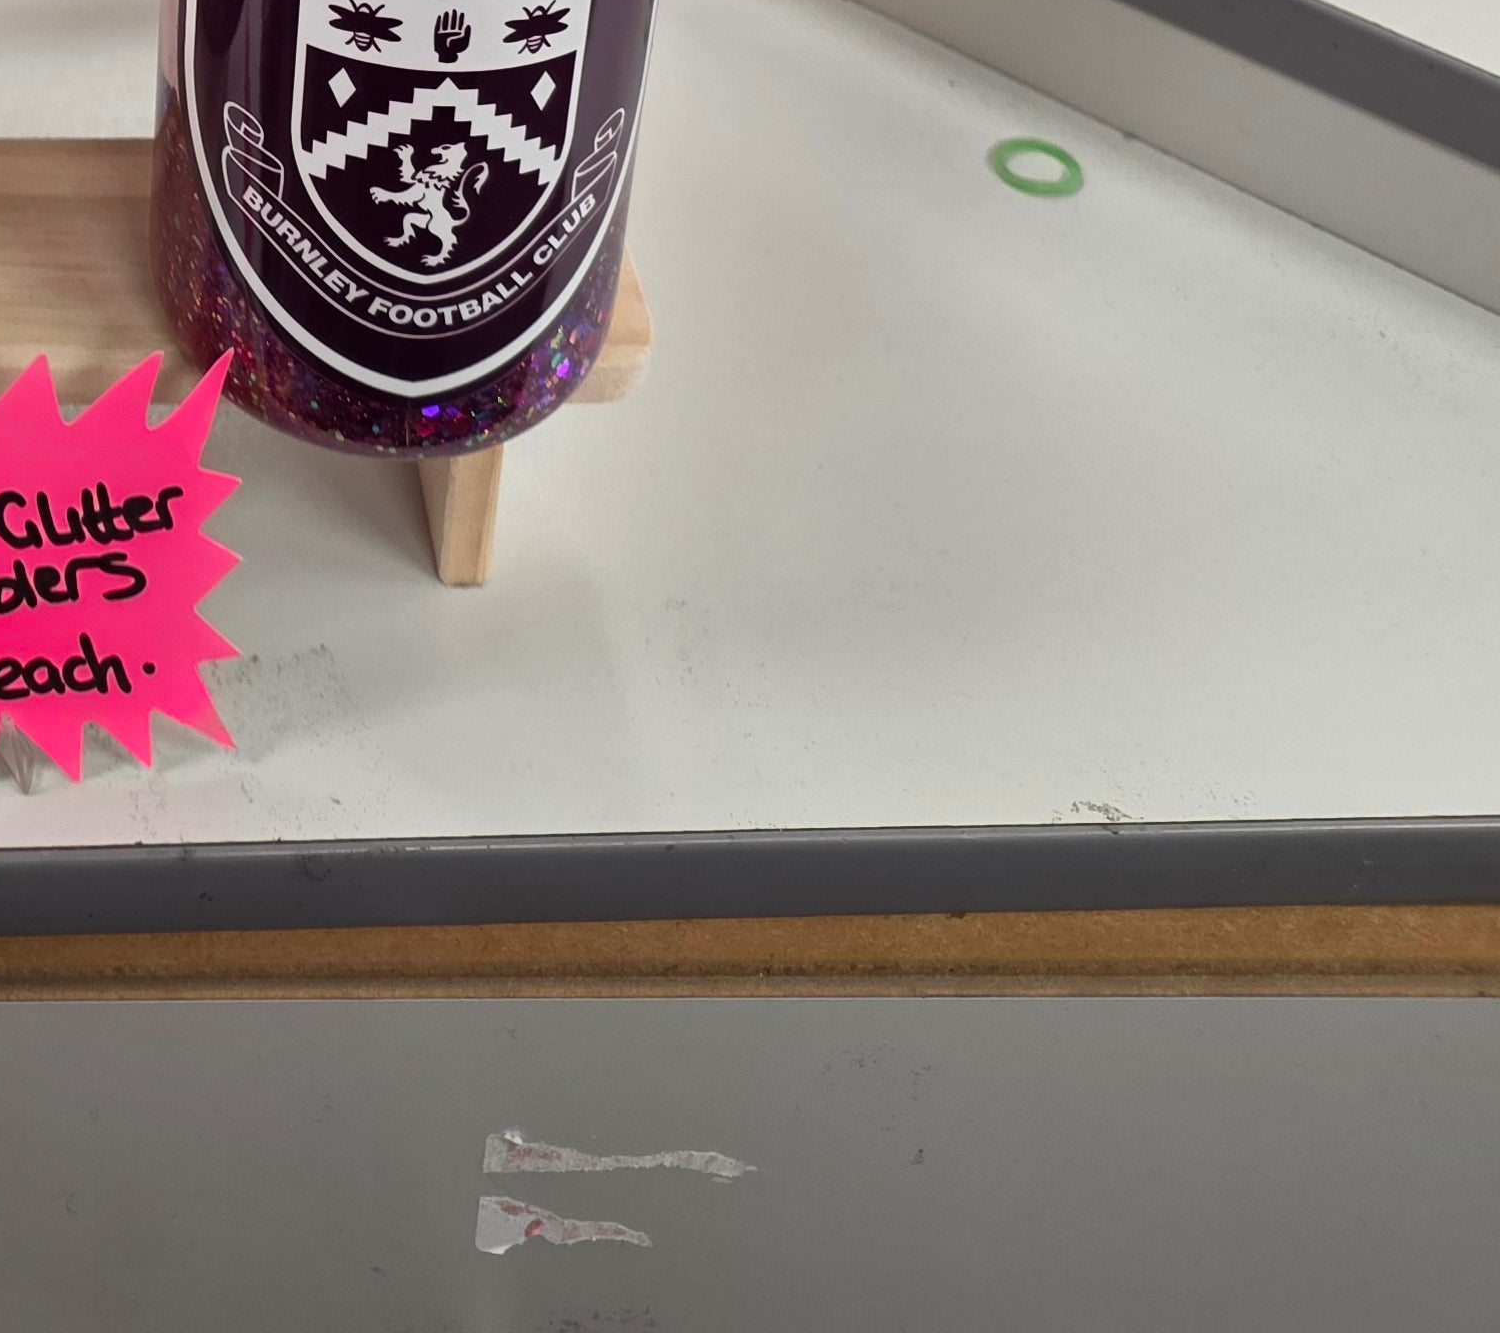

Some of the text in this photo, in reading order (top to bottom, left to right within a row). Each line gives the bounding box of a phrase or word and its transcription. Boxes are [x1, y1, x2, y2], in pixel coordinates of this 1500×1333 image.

[243, 183, 597, 328] BURNLEY FOOTBALL CLUB
